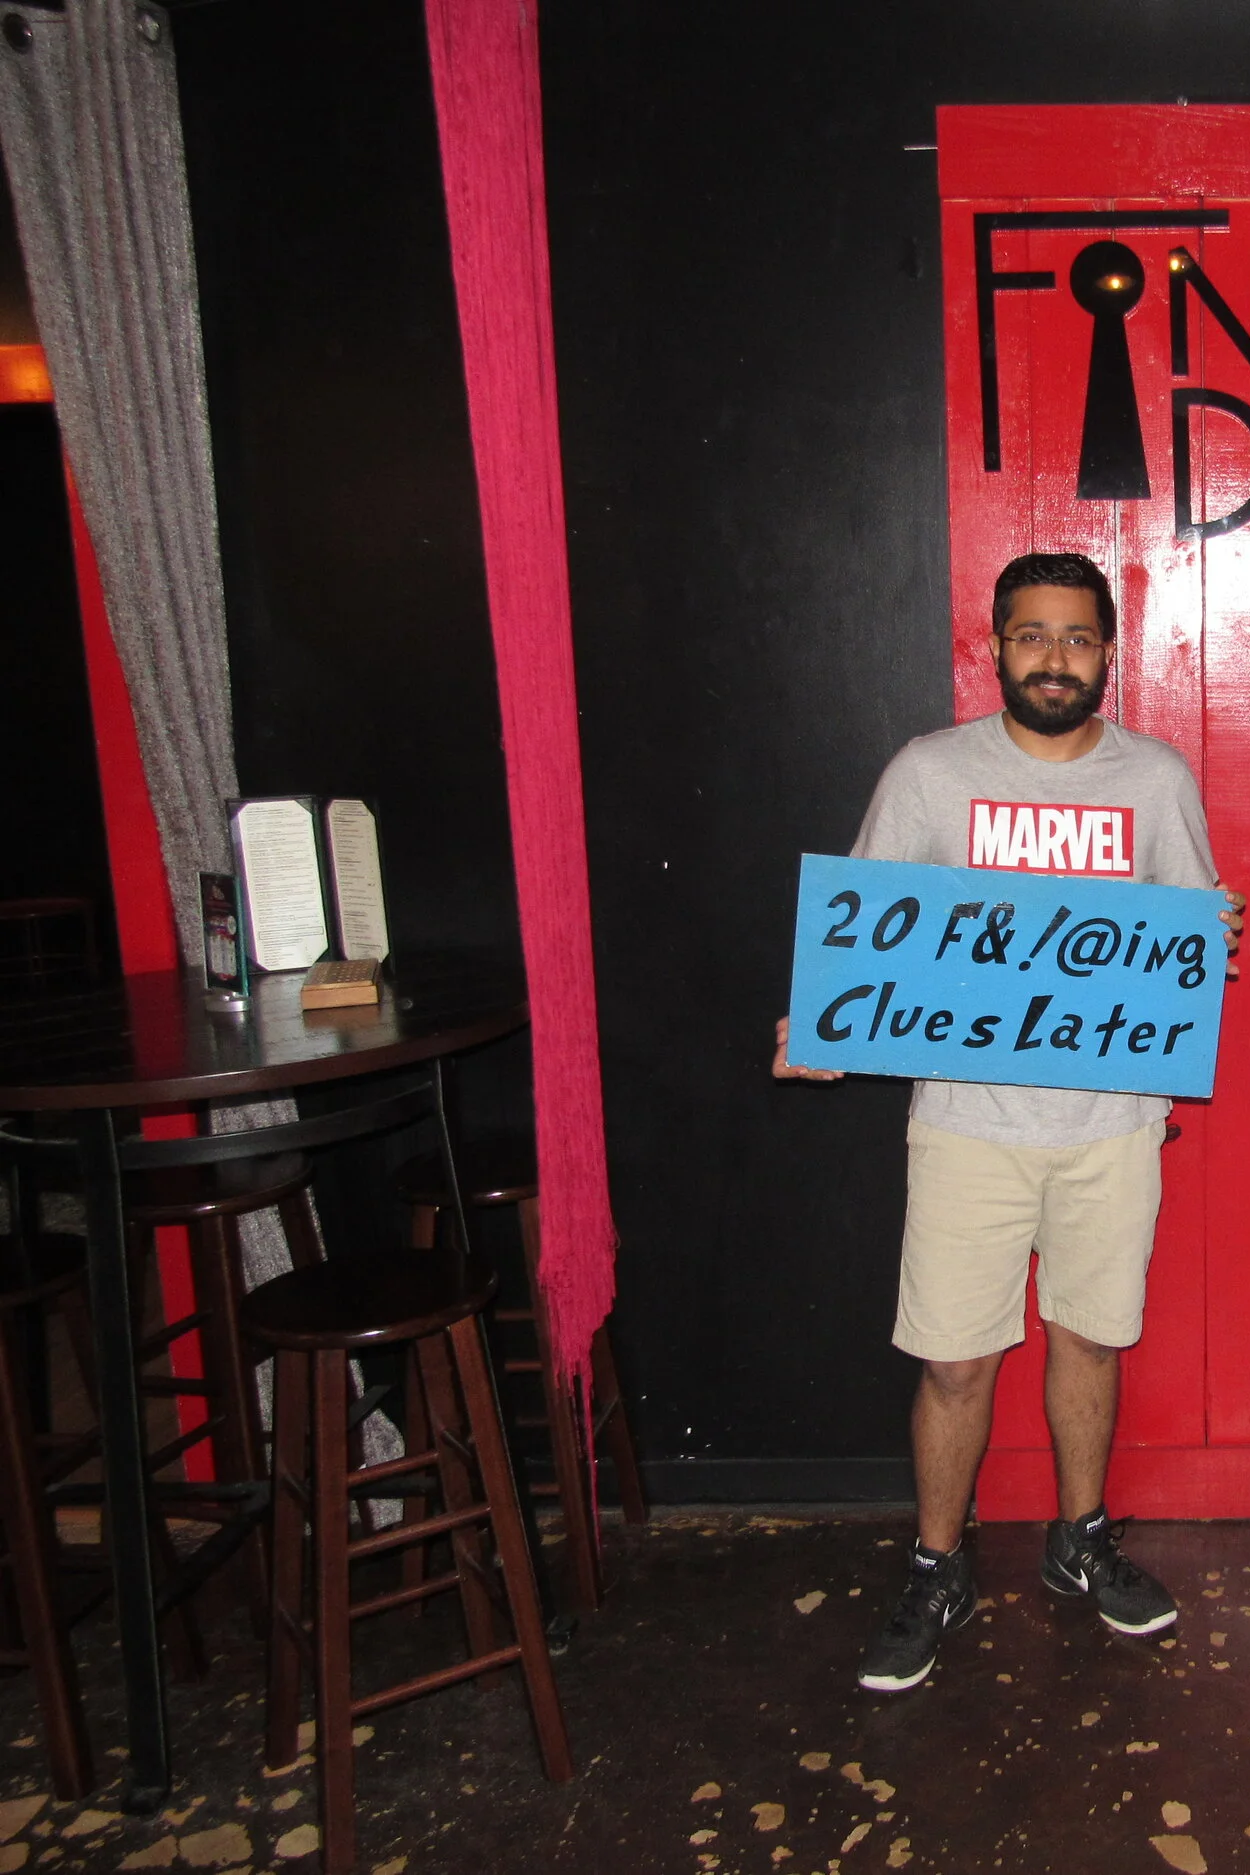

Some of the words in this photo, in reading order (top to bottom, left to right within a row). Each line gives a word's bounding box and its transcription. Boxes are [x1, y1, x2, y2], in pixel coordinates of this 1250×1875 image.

[972, 804, 1130, 872] MARVEL
[822, 890, 921, 952] 20
[816, 981, 1002, 1049] Clues
[1013, 994, 1195, 1058] Later
